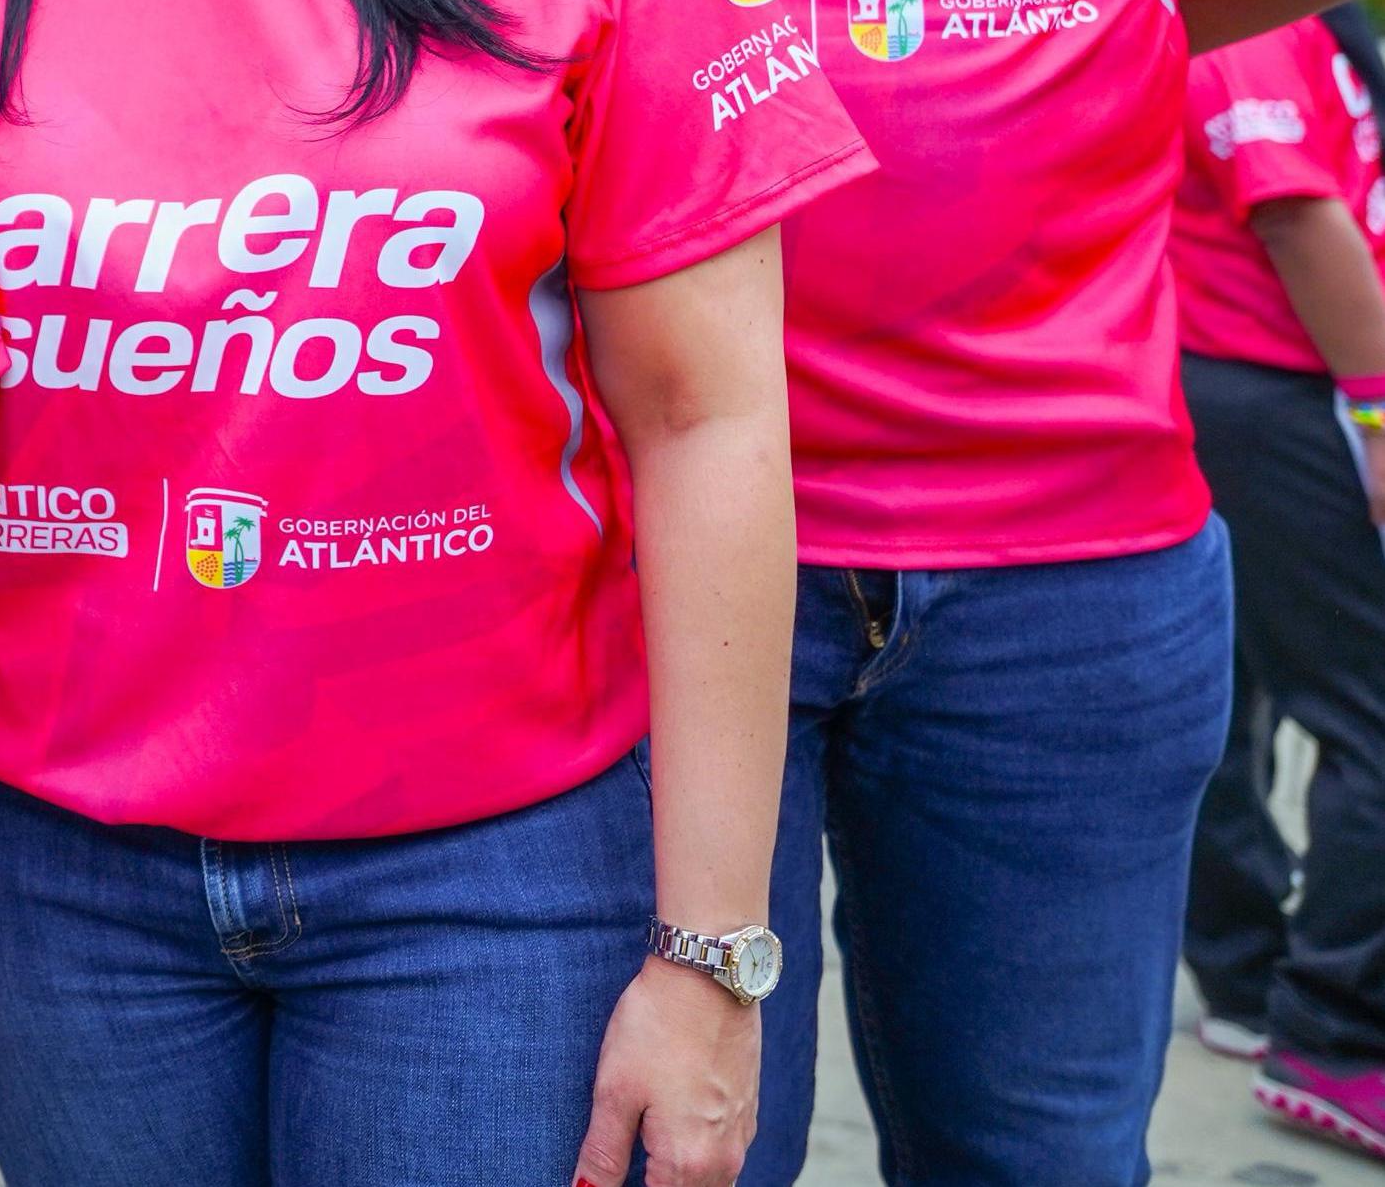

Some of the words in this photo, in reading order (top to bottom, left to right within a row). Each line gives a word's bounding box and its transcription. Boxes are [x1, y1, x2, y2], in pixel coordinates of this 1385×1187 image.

[692, 14, 799, 91] GOBERNAC
[710, 36, 821, 133] ATLÁN
[277, 523, 495, 570] ATLÁNTICO
[278, 509, 447, 537] GOBERNACIÓN
[452, 503, 493, 525] DEL
